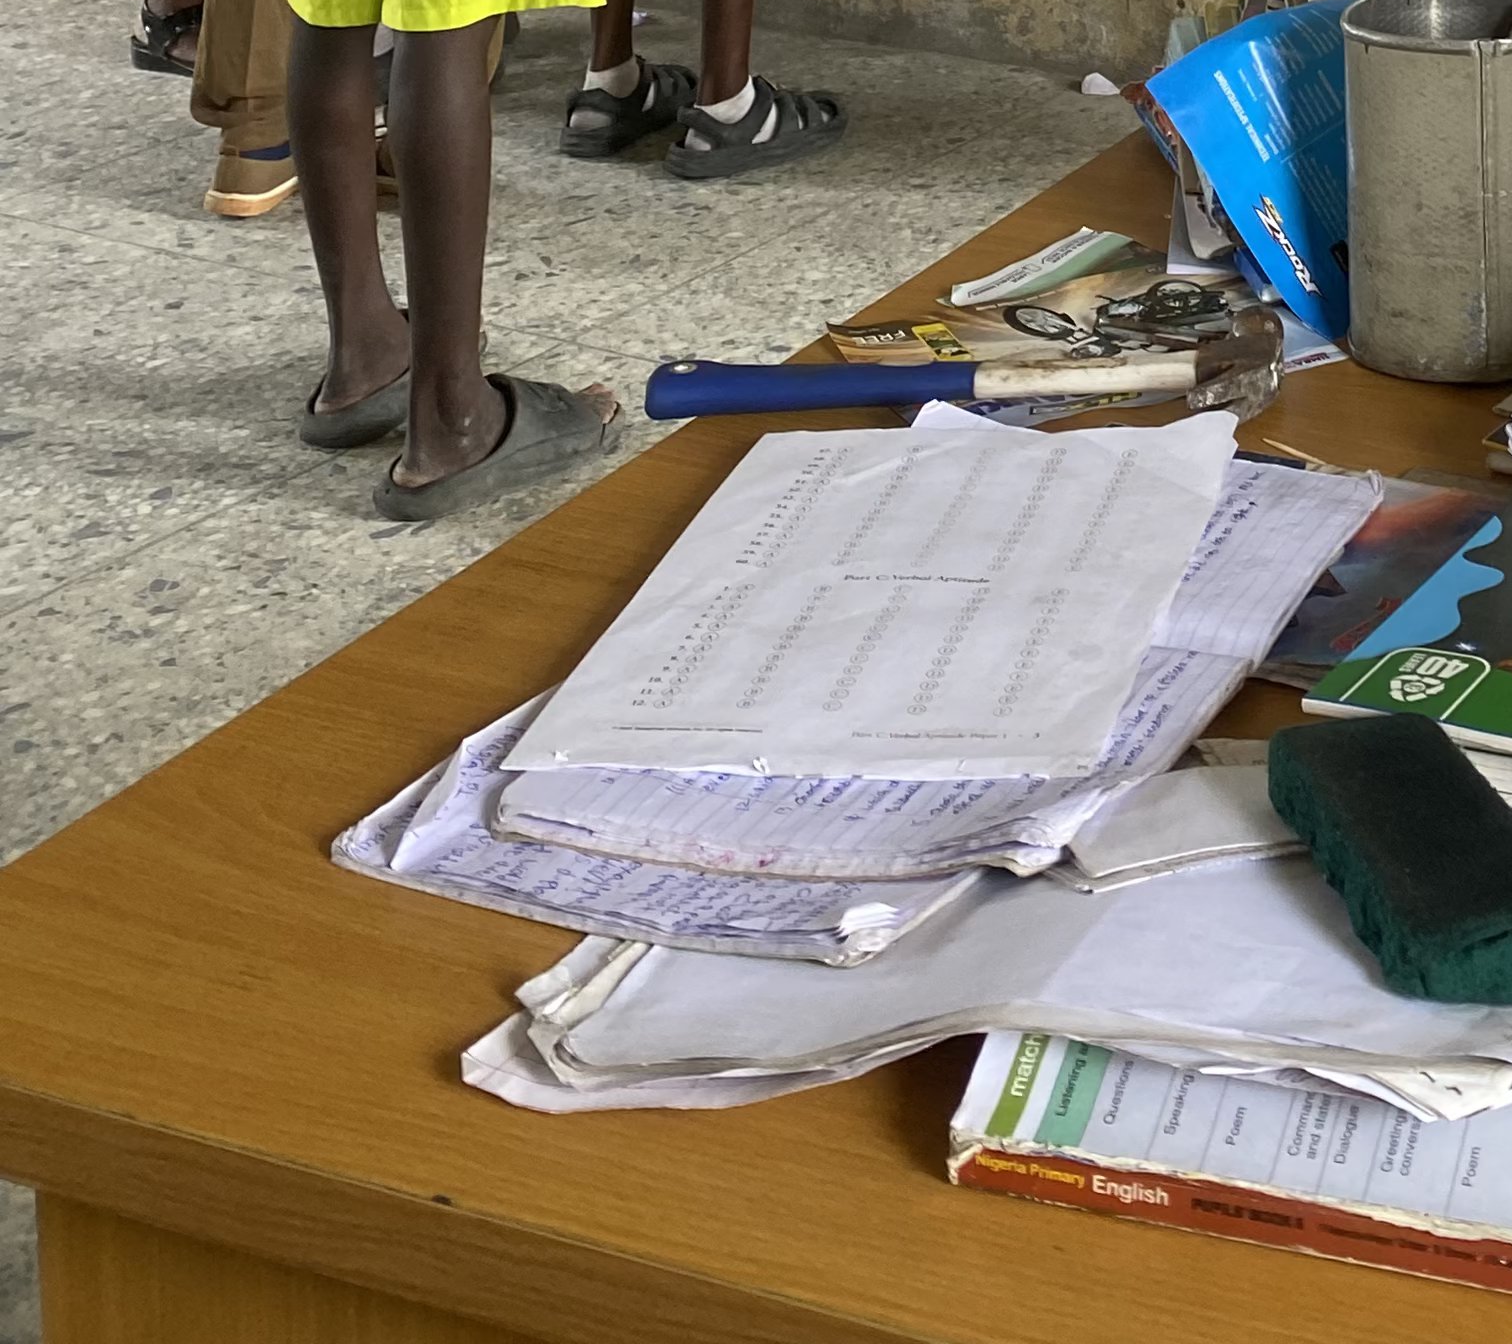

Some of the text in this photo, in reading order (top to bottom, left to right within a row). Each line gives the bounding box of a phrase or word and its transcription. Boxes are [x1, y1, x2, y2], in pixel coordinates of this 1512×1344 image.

[1416, 656, 1469, 679] 40
[1056, 1056, 1087, 1117] Listening
[1103, 1059, 1134, 1125] Questions
[1163, 1067, 1195, 1135] Speaking
[1225, 1106, 1247, 1146] Poem
[1307, 1133, 1321, 1160] and
[1333, 1105, 1360, 1164] Dialogue
[975, 1153, 1027, 1176] Nigeria
[1029, 1161, 1086, 1189] Primary
[1092, 1174, 1170, 1207] English
[1461, 1145, 1481, 1187] Poem
